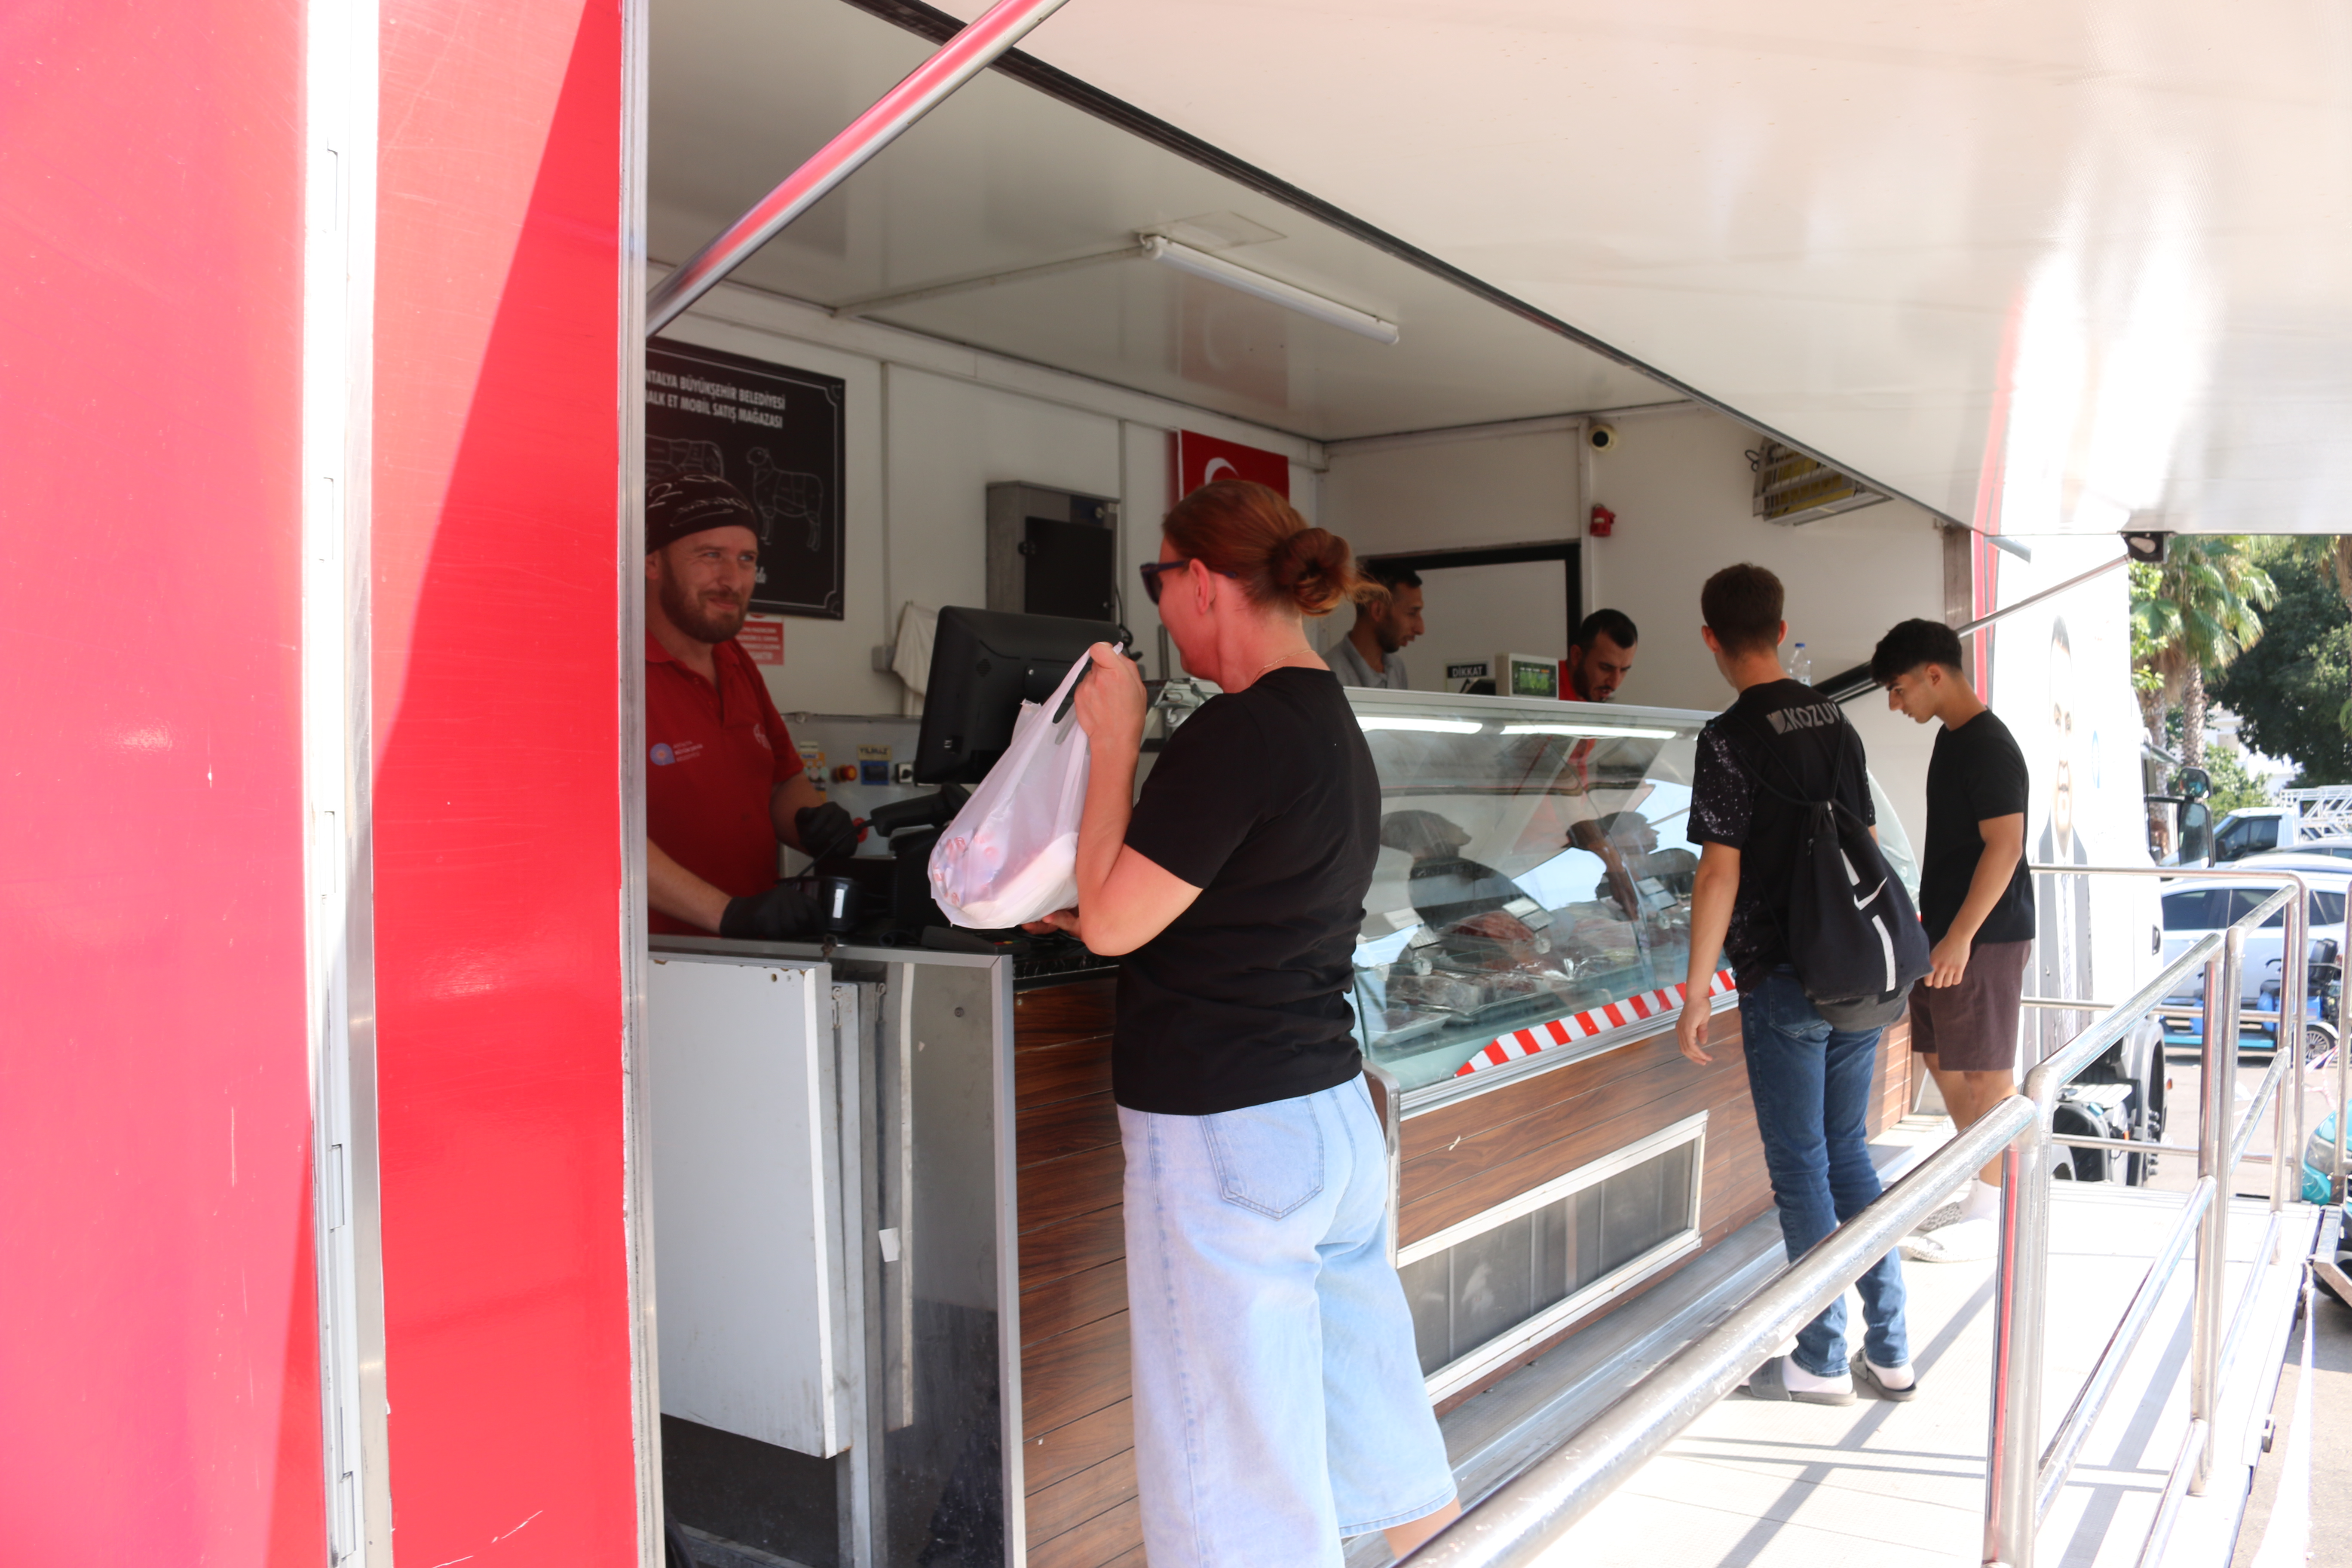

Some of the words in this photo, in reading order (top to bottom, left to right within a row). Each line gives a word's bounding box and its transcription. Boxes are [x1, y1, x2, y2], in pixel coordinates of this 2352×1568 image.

[646, 389, 666, 406] ALK
[667, 393, 678, 408] ET
[680, 396, 711, 416] MOBİL
[712, 403, 736, 424] SATIŞ
[738, 407, 783, 429] MAĞAZASI
[680, 374, 737, 401] BÜYÜKŞEHİR
[738, 389, 786, 410] BELEDİYESİ
